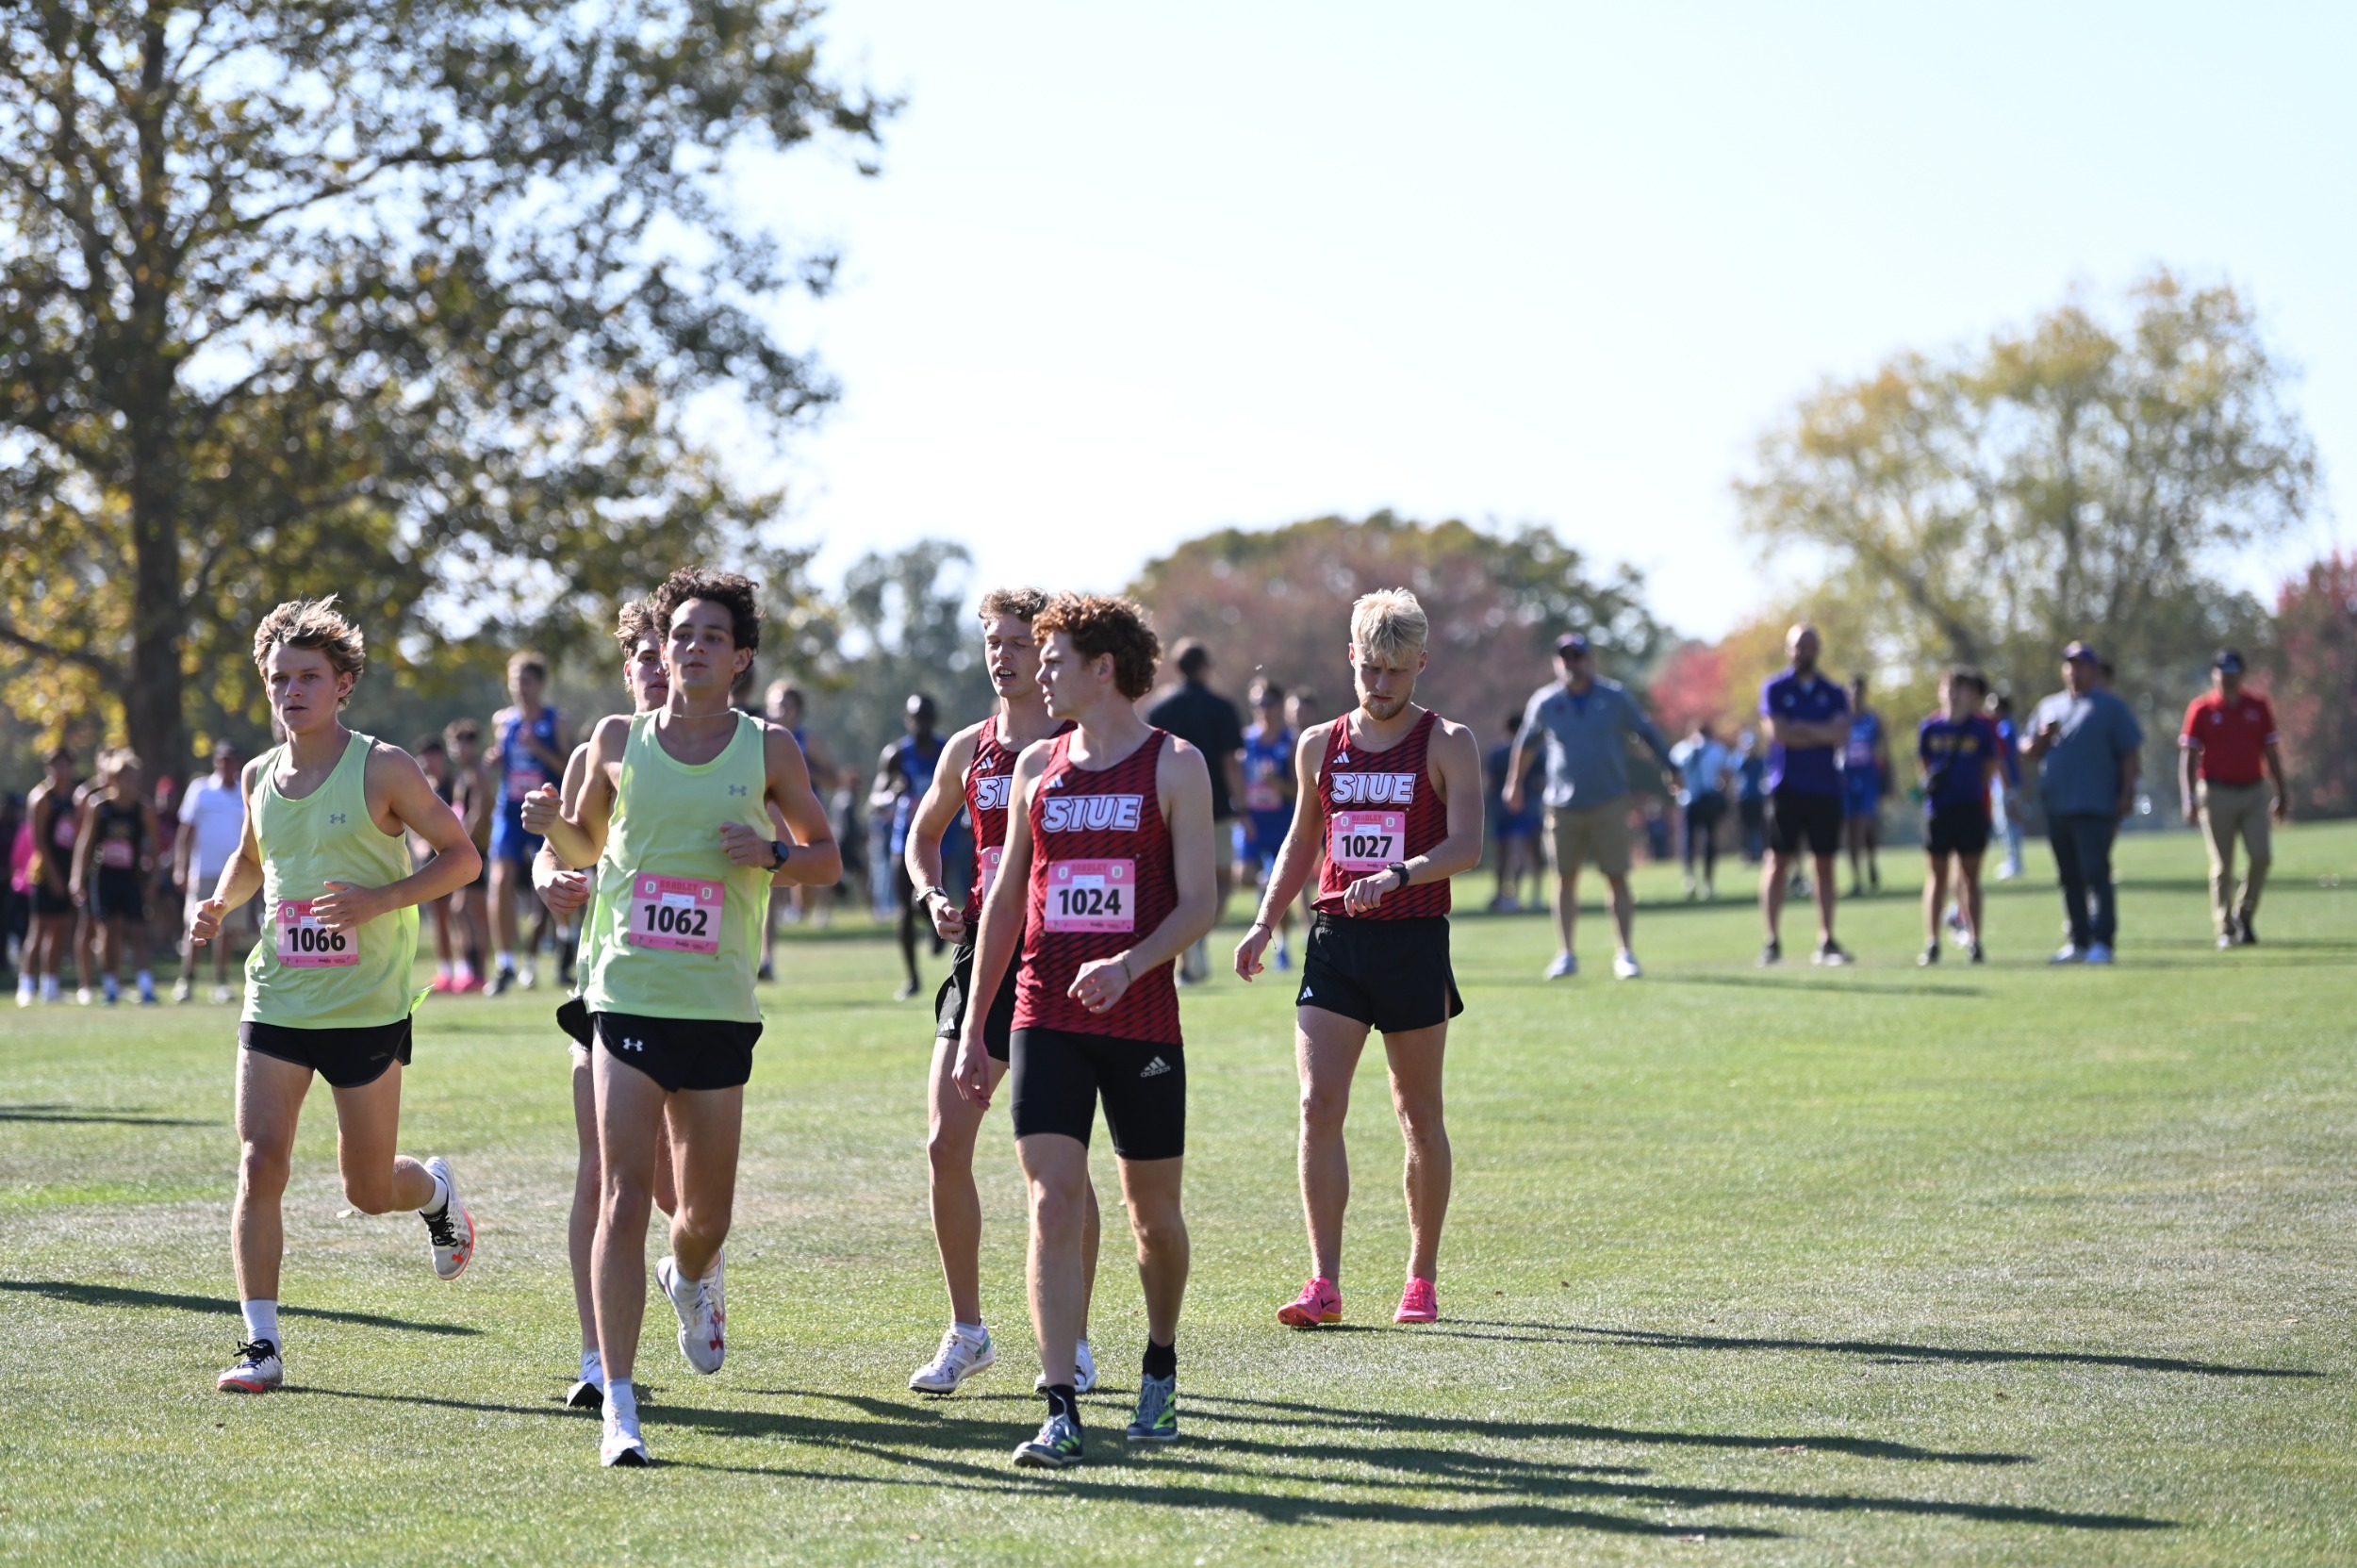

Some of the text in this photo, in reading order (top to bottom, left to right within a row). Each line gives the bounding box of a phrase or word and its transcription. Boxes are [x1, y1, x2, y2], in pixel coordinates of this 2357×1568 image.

[975, 775, 1013, 811] SI
[1330, 772, 1416, 803] SIUE
[1041, 794, 1144, 833] SIUE
[1342, 835, 1393, 858] 1027
[660, 880, 698, 892] BRADLEY
[1059, 889, 1121, 916] 1024
[644, 904, 708, 936] 1062
[288, 928, 346, 952] 1066
[1140, 1065, 1171, 1078] adidas
